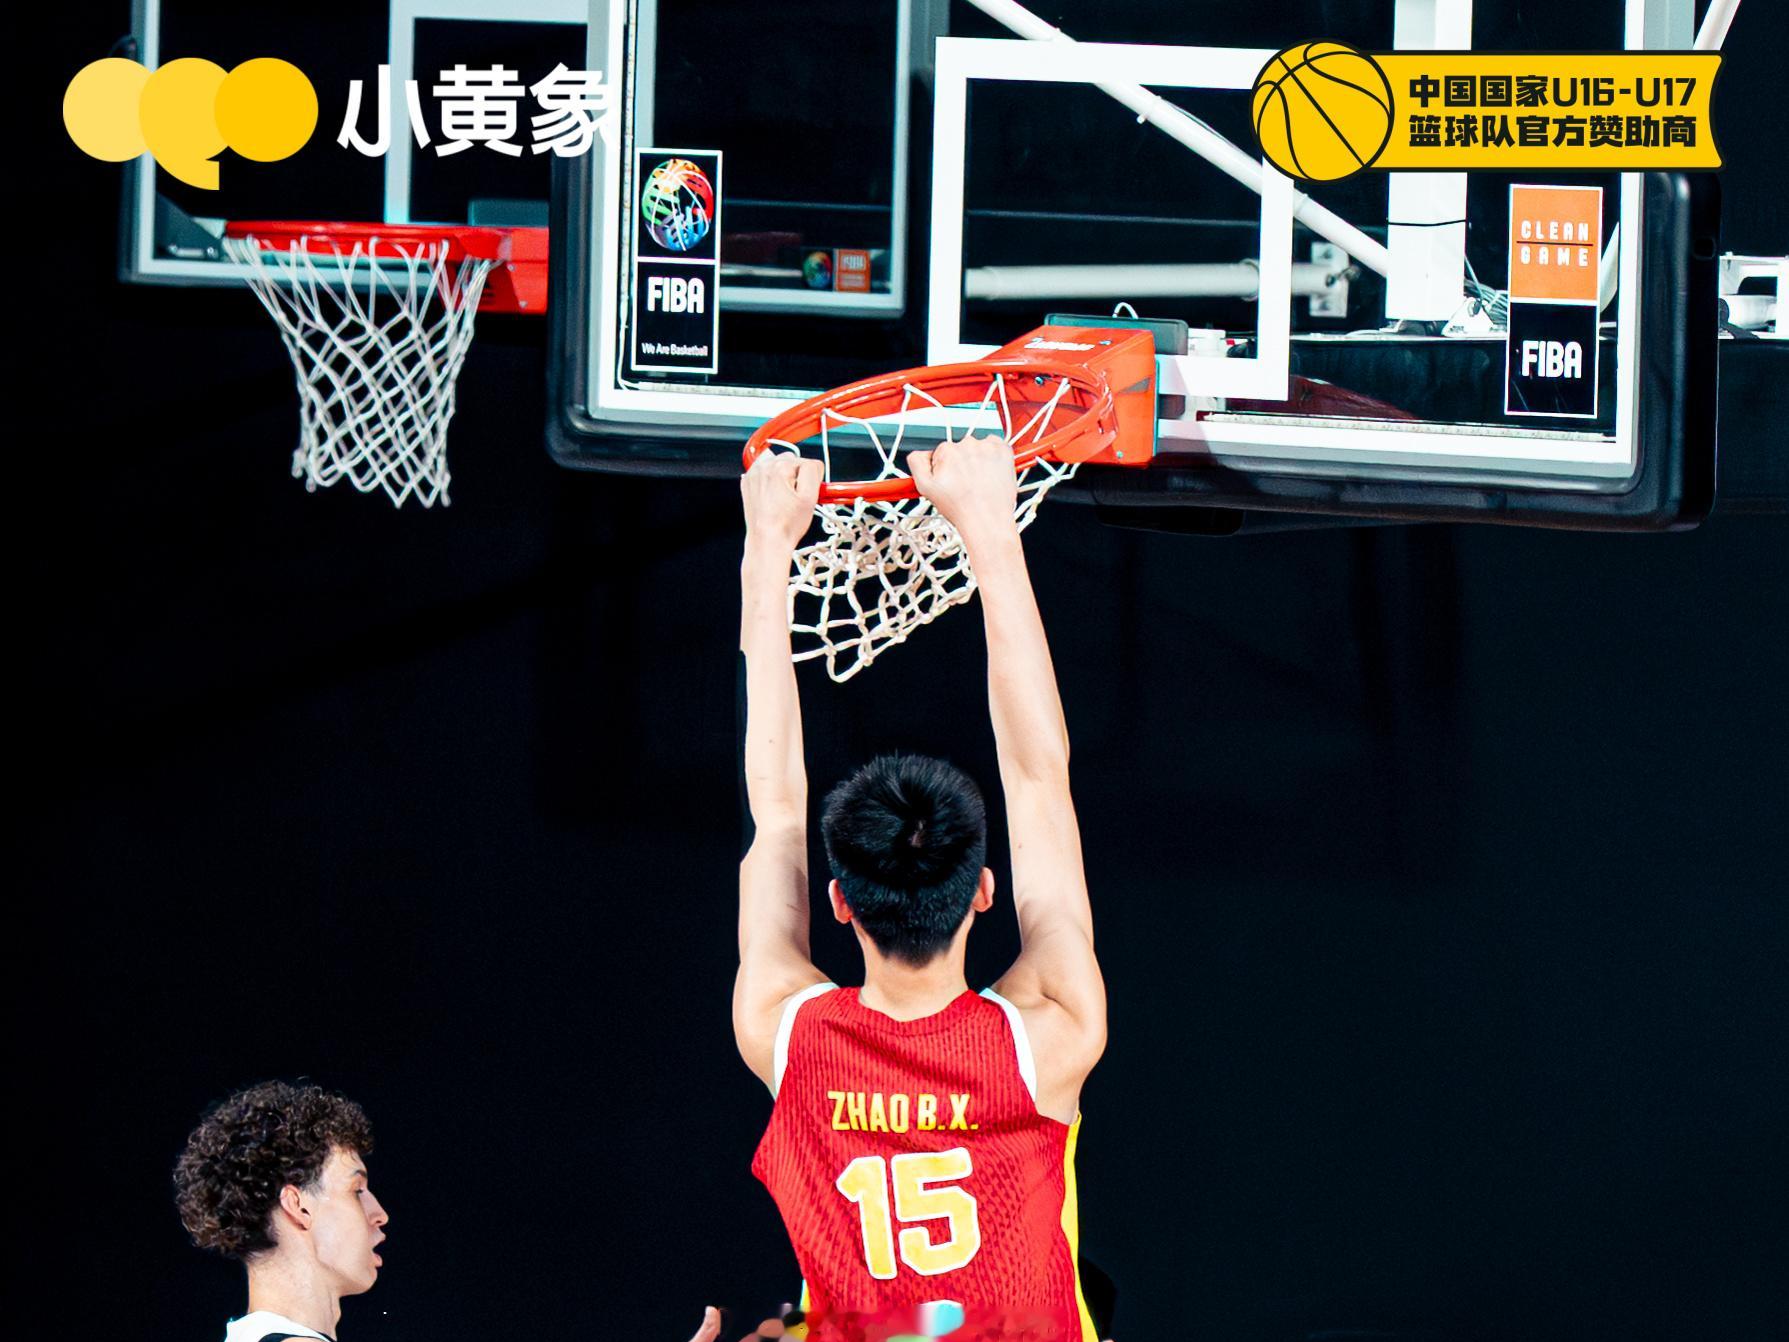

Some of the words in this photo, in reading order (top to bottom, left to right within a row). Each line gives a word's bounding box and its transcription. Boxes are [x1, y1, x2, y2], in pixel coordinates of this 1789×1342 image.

[1520, 219, 1589, 241] CLEAN
[1520, 246, 1588, 267] GAME
[647, 276, 705, 314] FIBA
[1521, 340, 1583, 379] FIBA
[827, 1091, 910, 1134] ZHAO
[835, 1147, 981, 1280] 15
